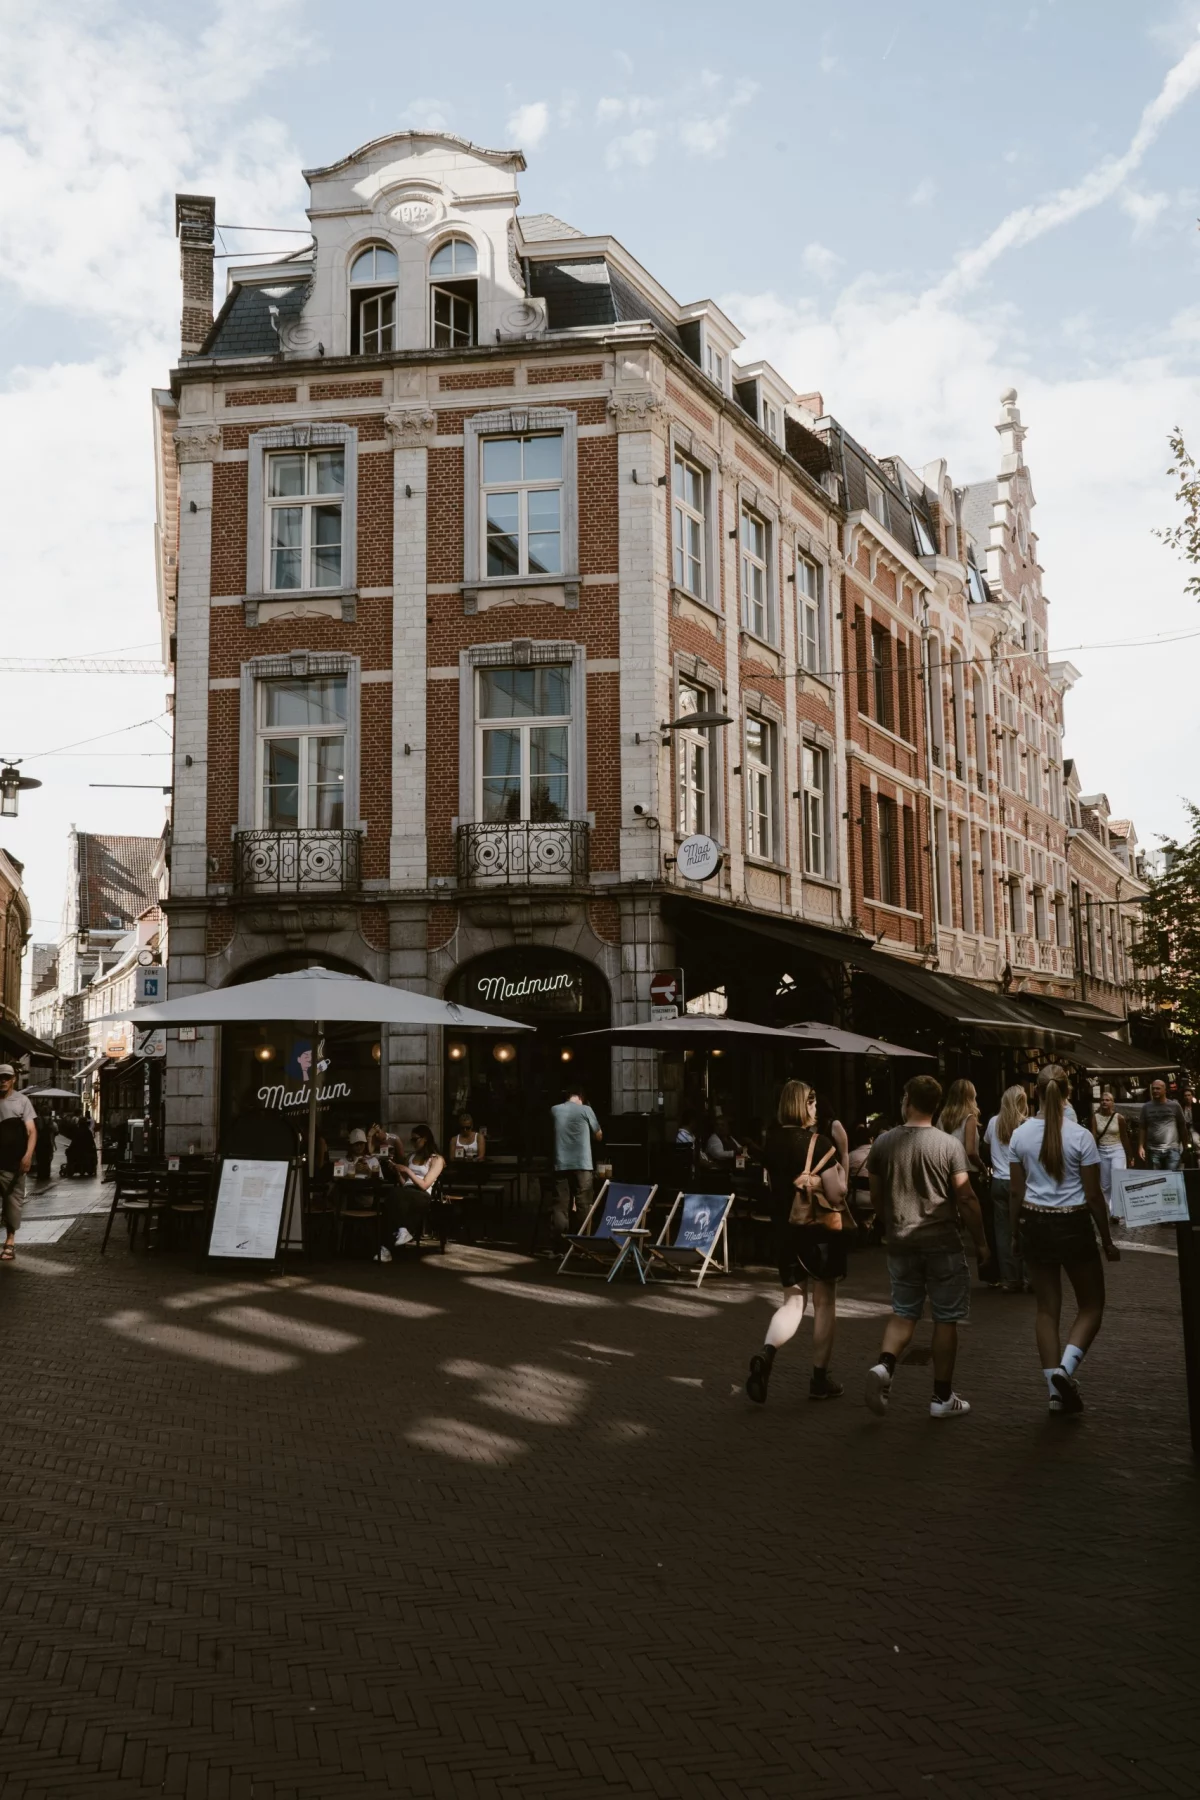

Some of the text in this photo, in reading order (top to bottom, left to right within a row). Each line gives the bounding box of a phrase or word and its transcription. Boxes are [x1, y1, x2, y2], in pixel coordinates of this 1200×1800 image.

[683, 840, 711, 857] Mad
[686, 853, 711, 866] mum
[477, 974, 573, 1001] Madmum
